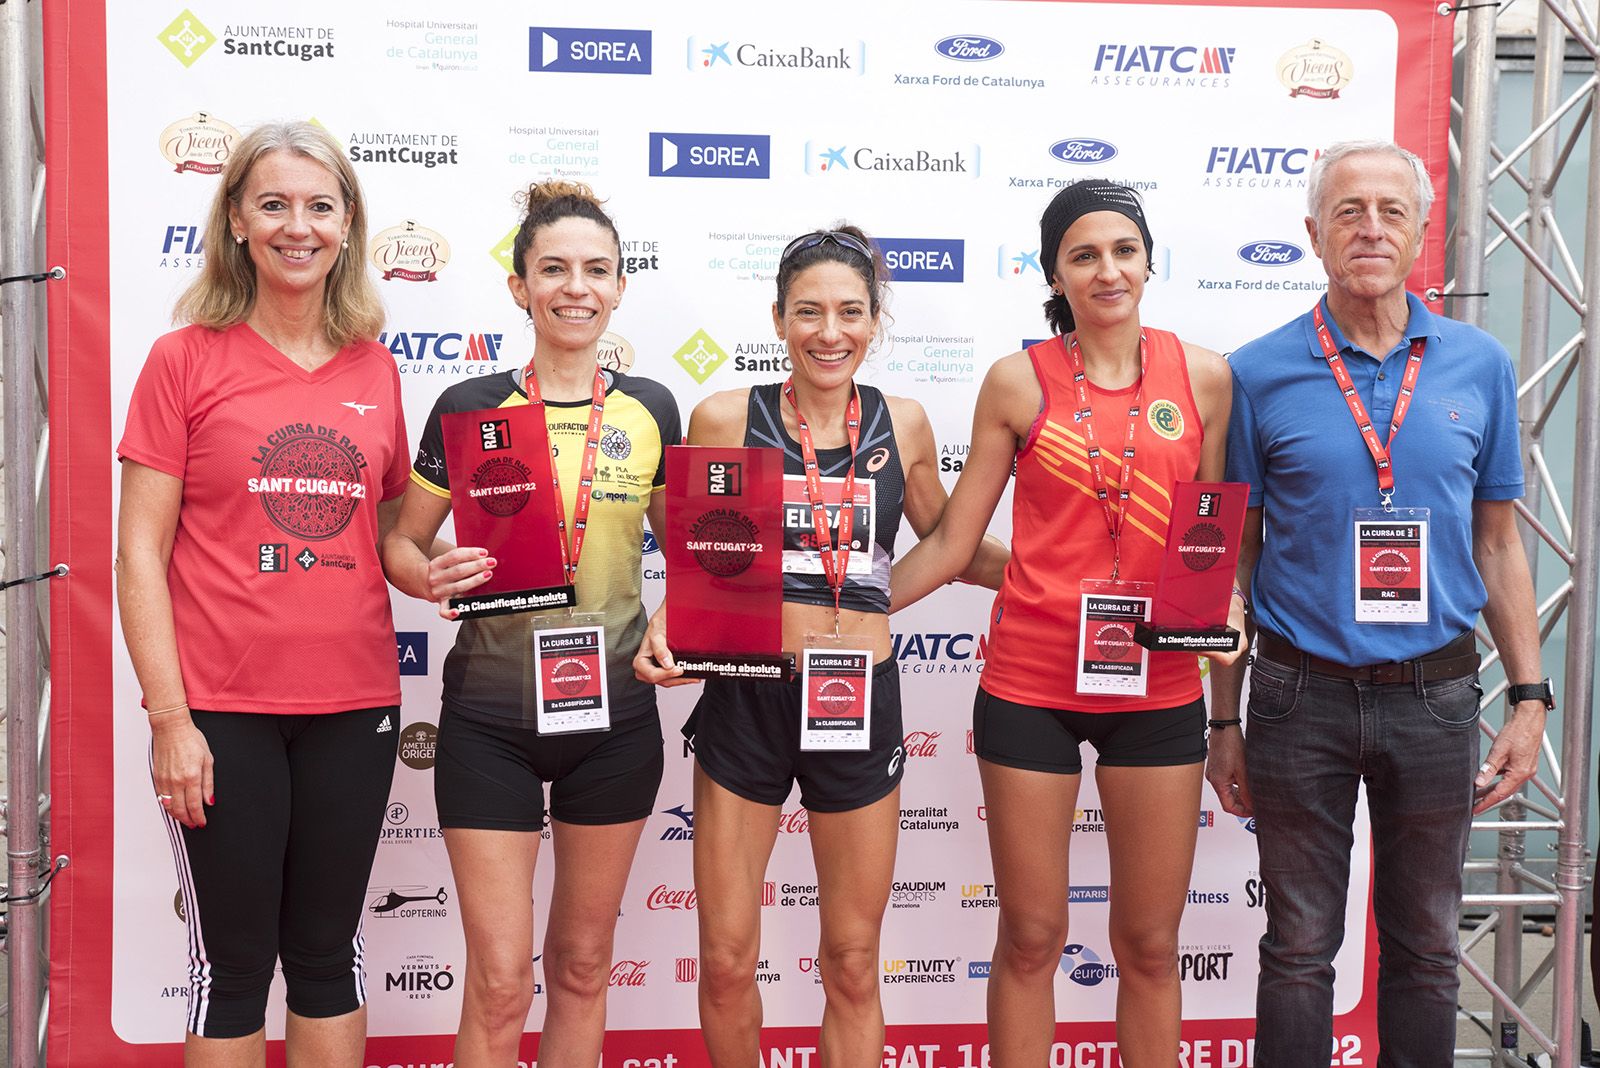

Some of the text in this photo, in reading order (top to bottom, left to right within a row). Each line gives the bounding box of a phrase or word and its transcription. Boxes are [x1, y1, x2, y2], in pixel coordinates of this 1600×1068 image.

[387, 20, 424, 29] Hospital
[224, 25, 334, 40] AJUNTAMENT DE
[425, 32, 478, 45] General
[223, 38, 335, 61] SantCugat
[386, 46, 478, 62] de Catalunya
[570, 41, 642, 62] SOREA
[737, 43, 852, 70] CaixaBank
[1094, 44, 1197, 74] FIATC
[1282, 58, 1349, 86] Vicens
[894, 74, 1045, 89] Xarxa Ford de Catalunya
[1091, 75, 1230, 88] ASSEGURANCES
[509, 126, 599, 136] Hospital Universitari
[350, 132, 458, 147] AJUNTAMENT DE
[547, 138, 599, 151] General
[166, 132, 233, 161] Vicens
[350, 145, 458, 169] SantCugat
[509, 152, 599, 168] de Catalunya
[690, 146, 760, 167] SOREA
[854, 148, 967, 173] CaixaBank
[1206, 146, 1308, 174] FIATC
[1009, 177, 1044, 188] Xarxa
[1203, 176, 1306, 188] ASSEGURAN
[709, 232, 745, 241] Hospital
[643, 241, 659, 252] DE
[374, 241, 446, 268] Vicens
[886, 251, 953, 270] SOREA
[708, 257, 725, 270] de
[393, 271, 427, 280] AGRAMUNT
[1198, 279, 1328, 292] Xarxa Ford de Catalun
[926, 335, 974, 344] Universitari
[735, 343, 788, 355] AJUNTA
[924, 346, 974, 358] General
[399, 363, 497, 375] GURANCES
[735, 355, 792, 372] SantC
[888, 360, 974, 375] de Catalunya
[547, 422, 588, 431] OURFACTOR
[481, 422, 498, 449] RAC
[251, 445, 271, 465] LA
[266, 423, 316, 445] CURSA
[317, 425, 338, 440] DE
[476, 457, 502, 472] CURSA
[503, 456, 514, 464] DE
[710, 464, 725, 494] RAC
[247, 477, 347, 496] SANT CUGAT
[469, 487, 492, 497] SANT
[493, 484, 521, 495] CUGAT
[1199, 494, 1212, 515] RAC
[689, 508, 741, 535] LA CURSA DE
[1362, 529, 1371, 537] LA
[1371, 529, 1395, 537] CURSA
[1396, 529, 1405, 537] DE
[686, 541, 713, 551] SANT
[714, 542, 746, 552] CUGAT
[1178, 545, 1195, 553] SANT
[260, 545, 274, 571] RAC
[321, 559, 356, 570] SantCugat
[458, 603, 470, 613] 2a
[471, 597, 527, 611] Classificada
[528, 592, 568, 604] absoluta
[1098, 603, 1120, 611] CURSA
[541, 640, 551, 648] LA
[551, 638, 574, 648] CURSA
[575, 637, 584, 645] DE
[891, 633, 973, 660] IATC
[1167, 636, 1206, 644] Classificada
[1206, 636, 1234, 644] absoluta
[677, 661, 781, 674] Classificada absoluta
[559, 700, 594, 708] CLASSIFICADA
[402, 742, 437, 750] AMETLLE
[899, 806, 948, 819] neralitat
[900, 819, 959, 832] Catalunya
[781, 884, 818, 894] Gener
[892, 882, 946, 892] GAUDIUM
[892, 892, 936, 901] SPORTS
[1068, 889, 1107, 899] UNTARIS
[1188, 890, 1229, 903] itness
[781, 896, 796, 906] de
[400, 909, 447, 918] COPTERING
[884, 959, 955, 972] UPTIVITY
[1178, 952, 1234, 981] PORT
[385, 964, 454, 991] MIRÓ
[884, 974, 955, 984] EXPERIENCES
